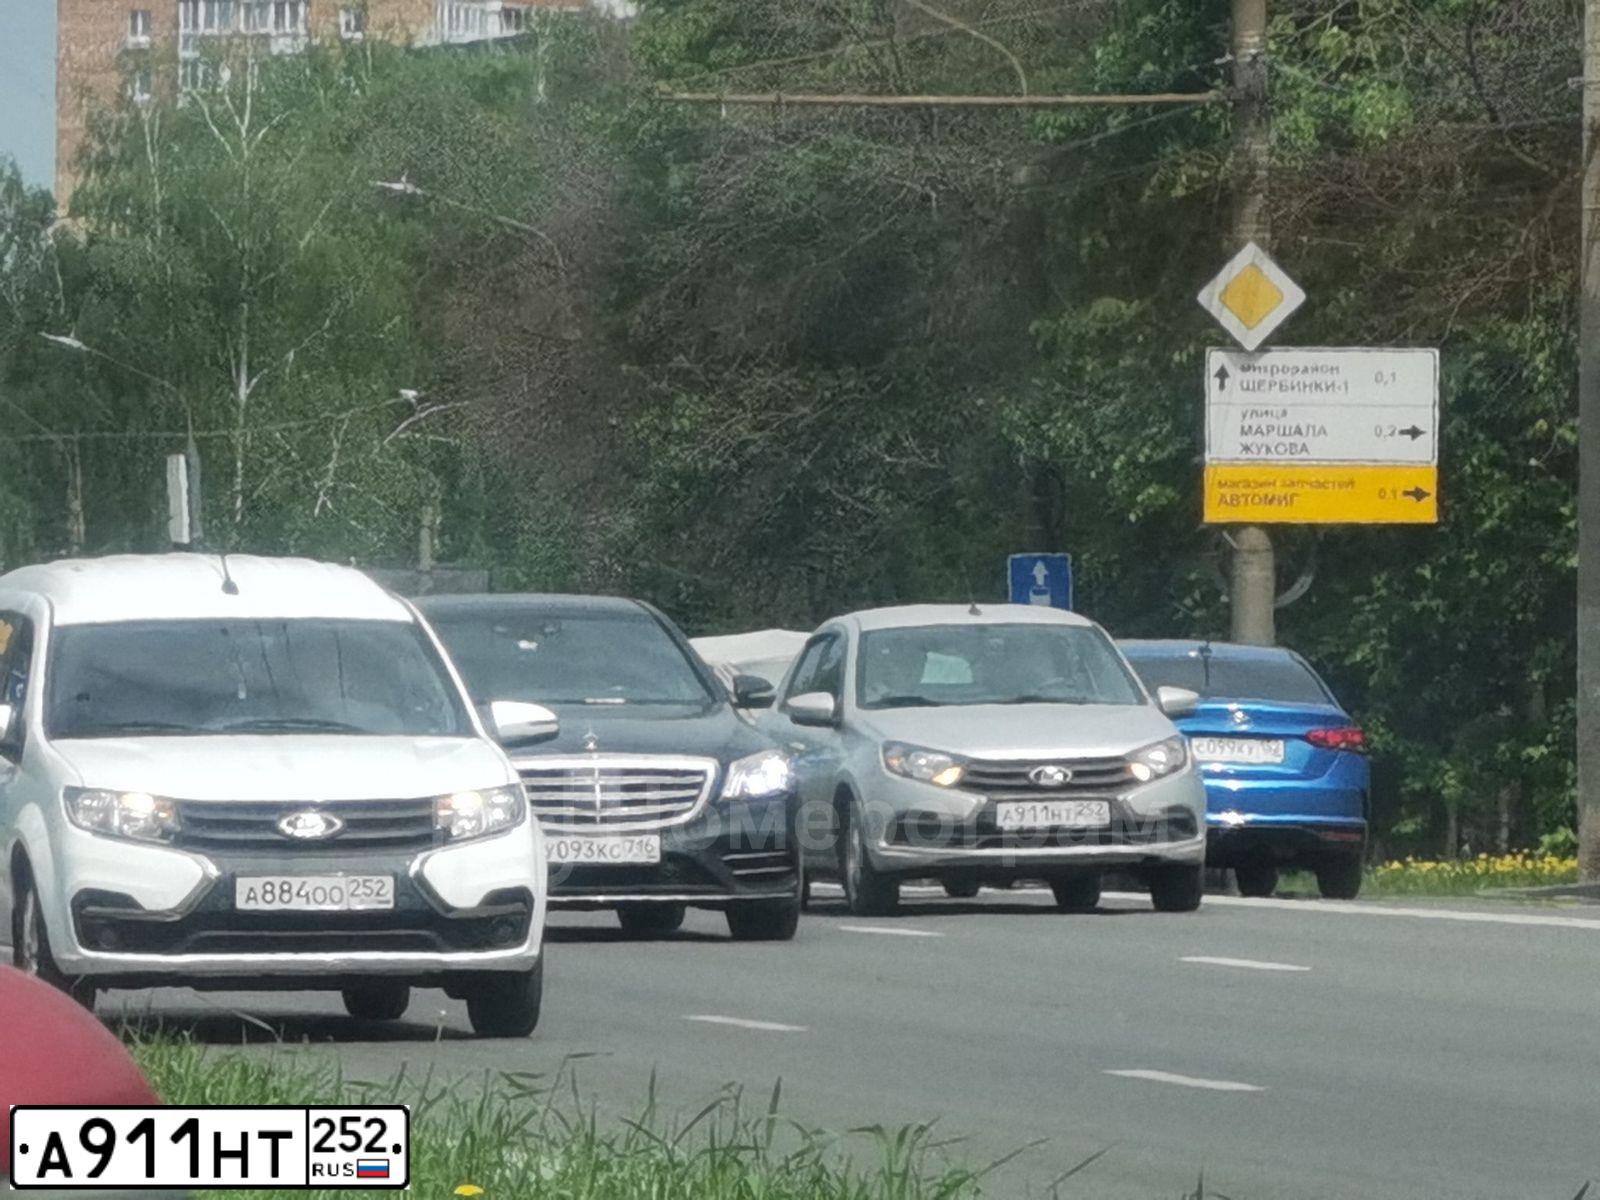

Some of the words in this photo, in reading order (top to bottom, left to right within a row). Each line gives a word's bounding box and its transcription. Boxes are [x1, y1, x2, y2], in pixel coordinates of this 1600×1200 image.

[1374, 371, 1397, 385] 0,1
[1240, 409, 1288, 420] улица
[1240, 424, 1328, 437] МАРШАЛА
[1374, 425, 1397, 440] 0,2
[1239, 442, 1311, 455] ЖУКОВА
[1217, 493, 1299, 507] АВТОМИГ
[349, 879, 387, 898] 252
